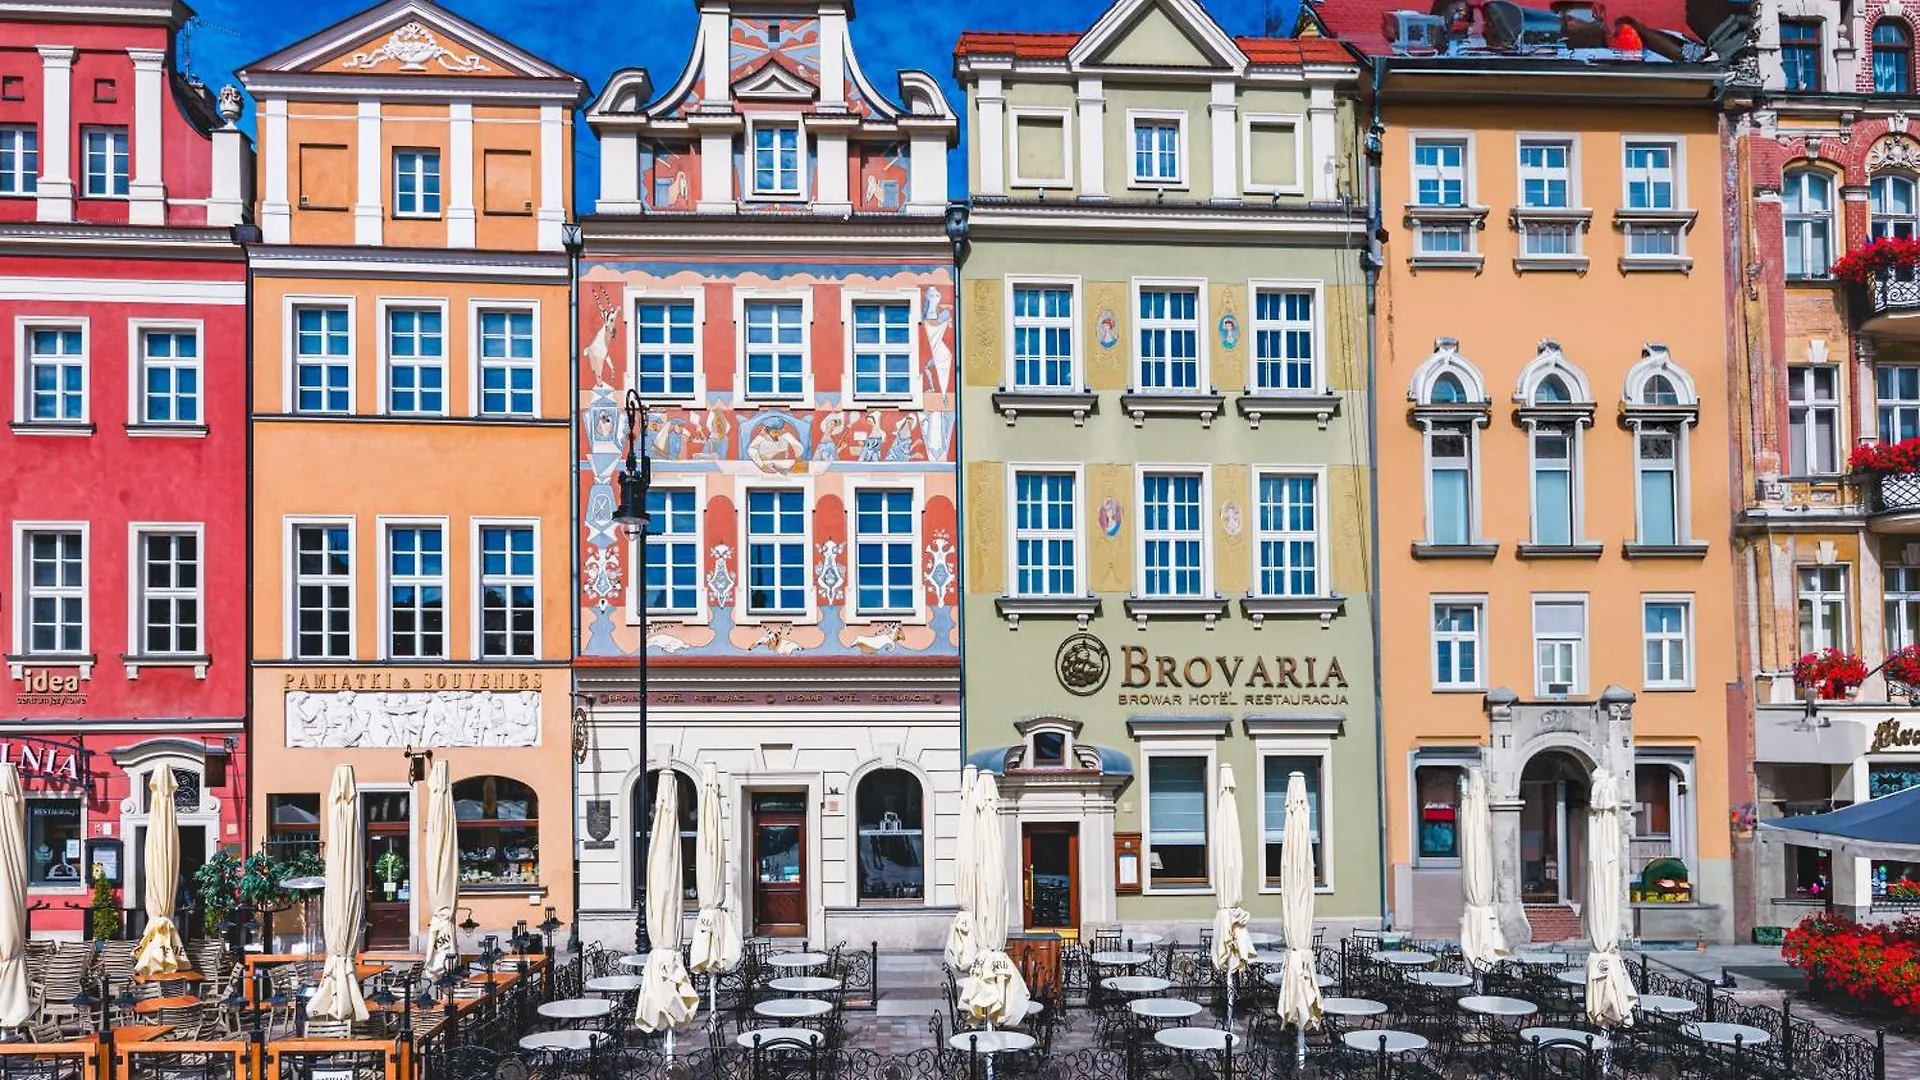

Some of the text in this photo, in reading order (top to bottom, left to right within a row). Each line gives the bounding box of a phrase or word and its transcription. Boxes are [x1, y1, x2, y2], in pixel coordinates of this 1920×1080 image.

[1120, 644, 1349, 688] BROVARIA
[24, 668, 80, 694] idea
[402, 677, 411, 689] &
[422, 672, 542, 689] SOUVENIRS
[1118, 693, 1349, 706] BROWAR HOTEL RESTAURACJA
